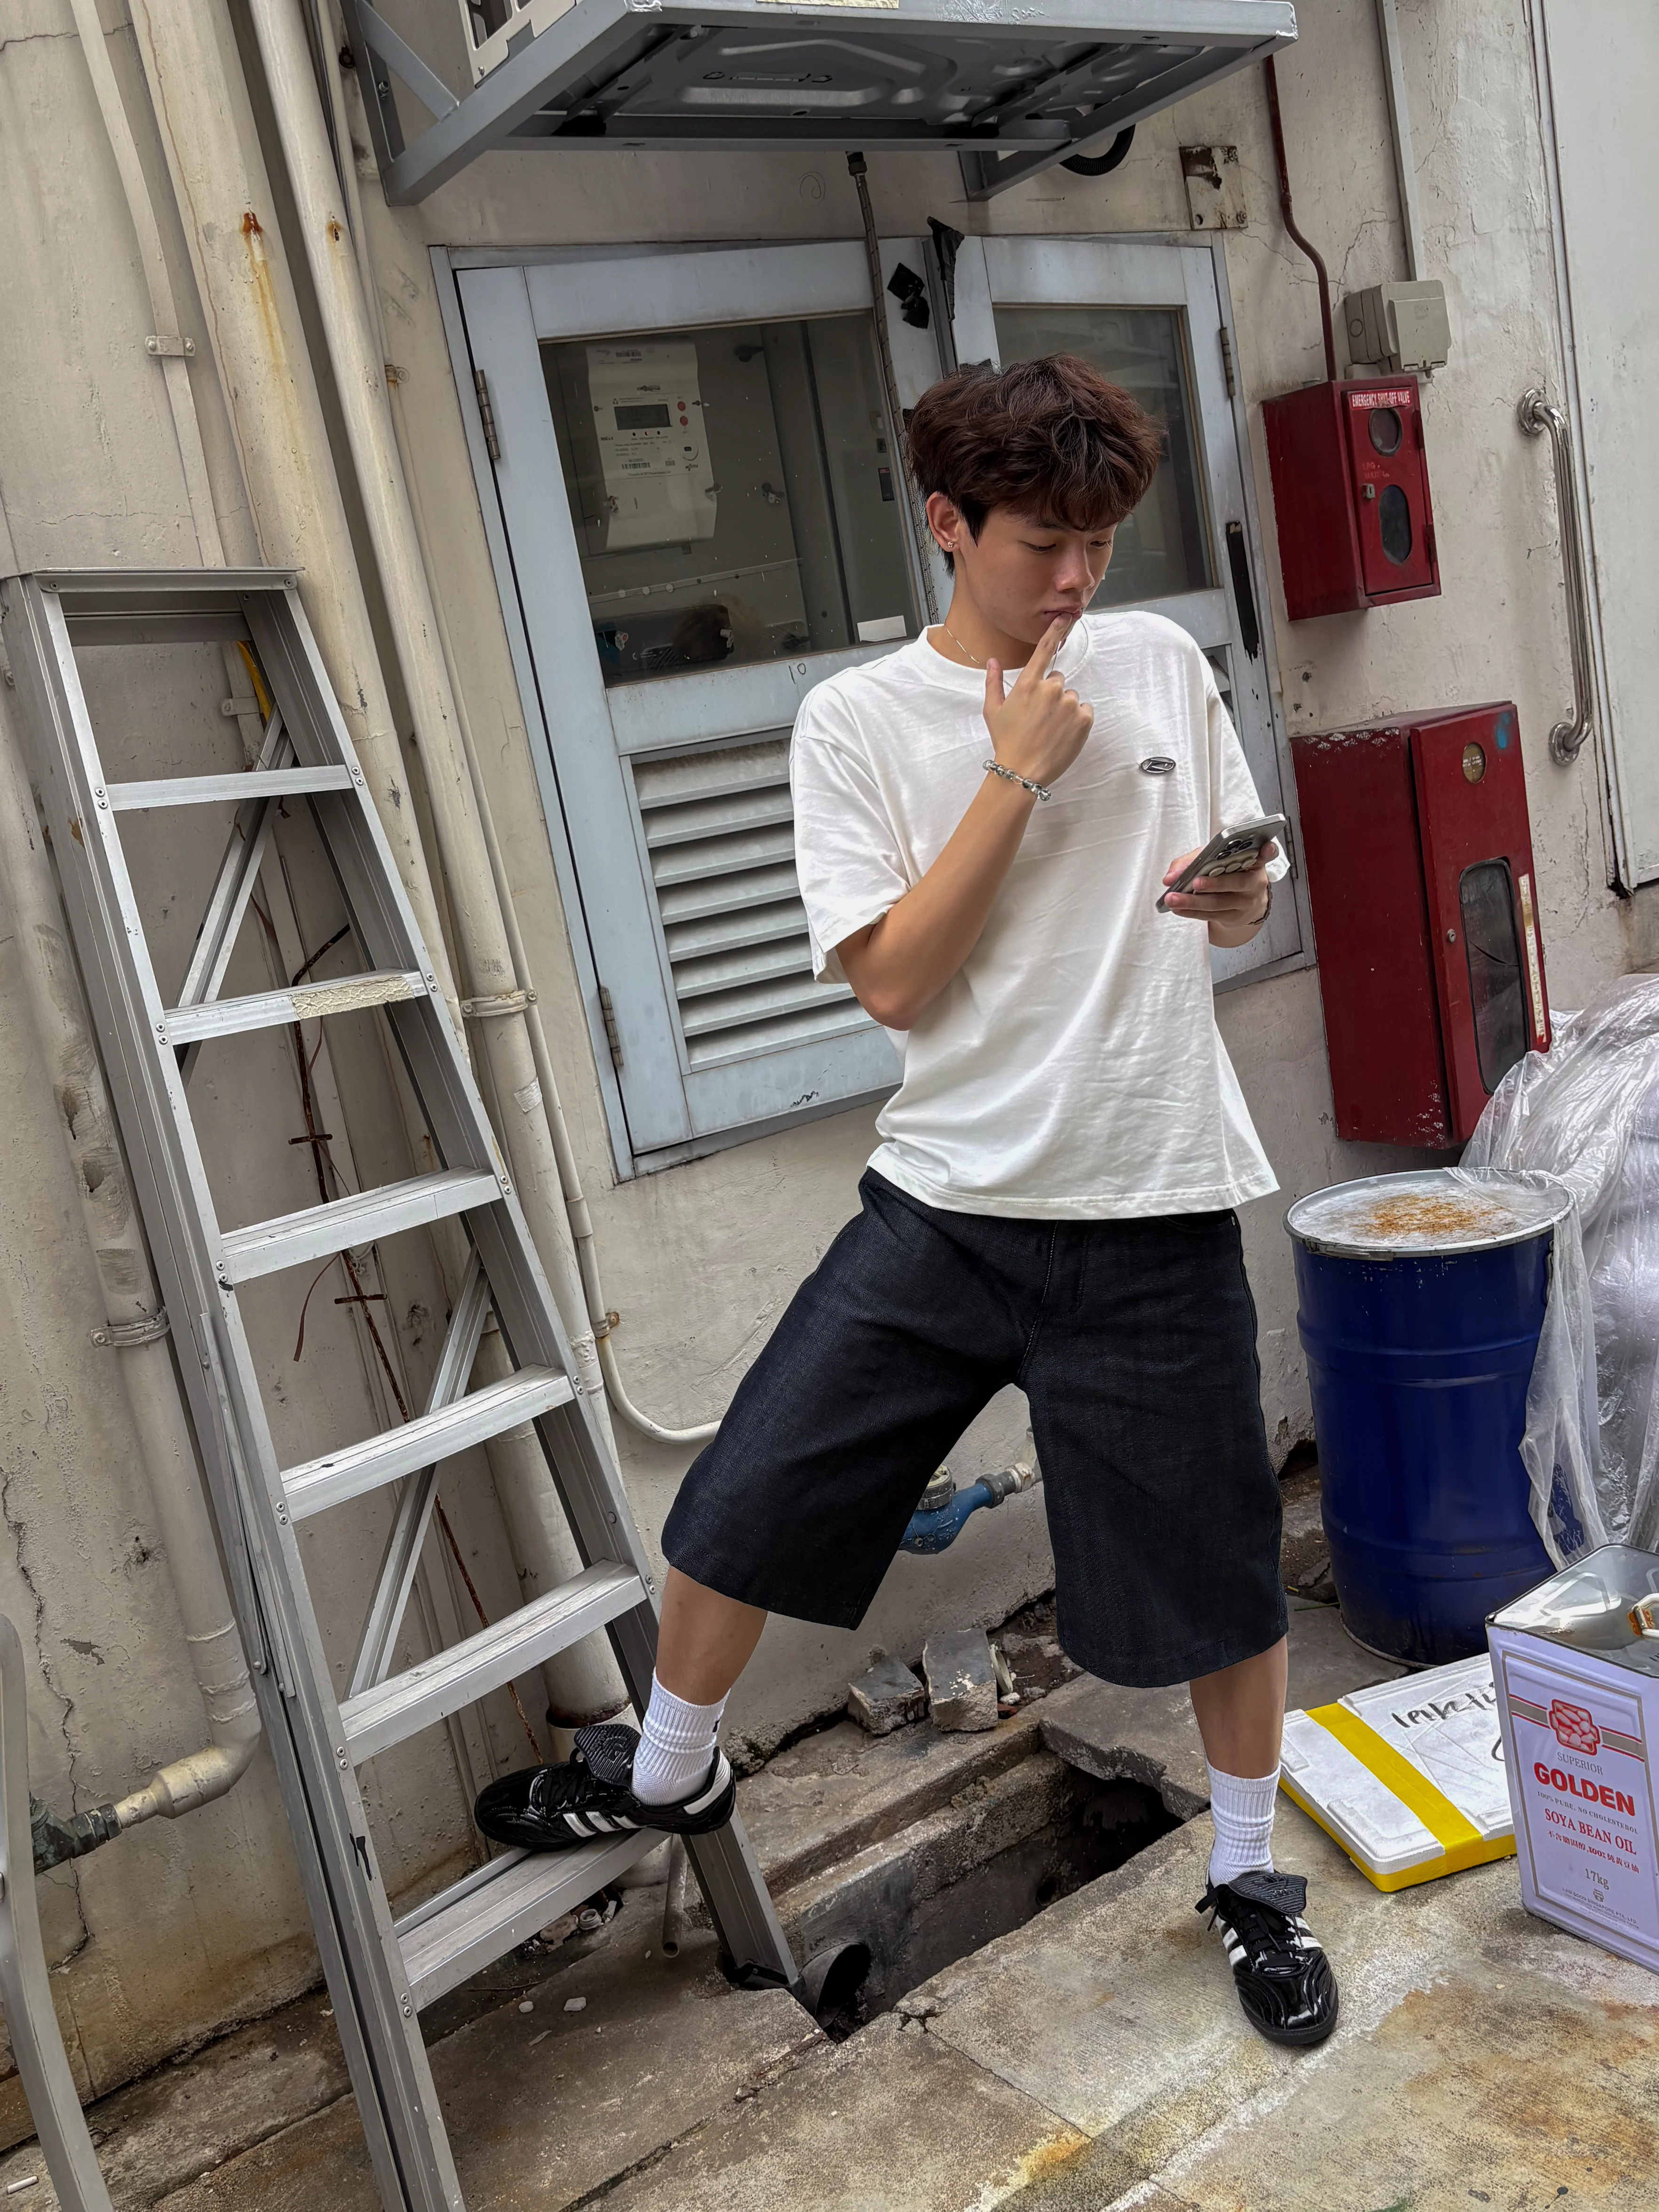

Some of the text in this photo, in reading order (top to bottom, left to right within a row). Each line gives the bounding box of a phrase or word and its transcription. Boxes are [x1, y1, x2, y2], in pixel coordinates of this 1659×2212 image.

[1352, 393, 1377, 407] EMERGENCY
[1397, 391, 1410, 404] VALVE
[1557, 1752, 1603, 1775] SUPERIOR
[1533, 1762, 1635, 1817] GOLDEN
[1537, 1791, 1554, 1802] 100%
[1578, 1806, 1588, 1815] NO
[1589, 1812, 1638, 1834] CHOLESTEROL
[1545, 1808, 1637, 1855] SOYA BEAN OIL
[1585, 1869, 1609, 1890] 17kg
